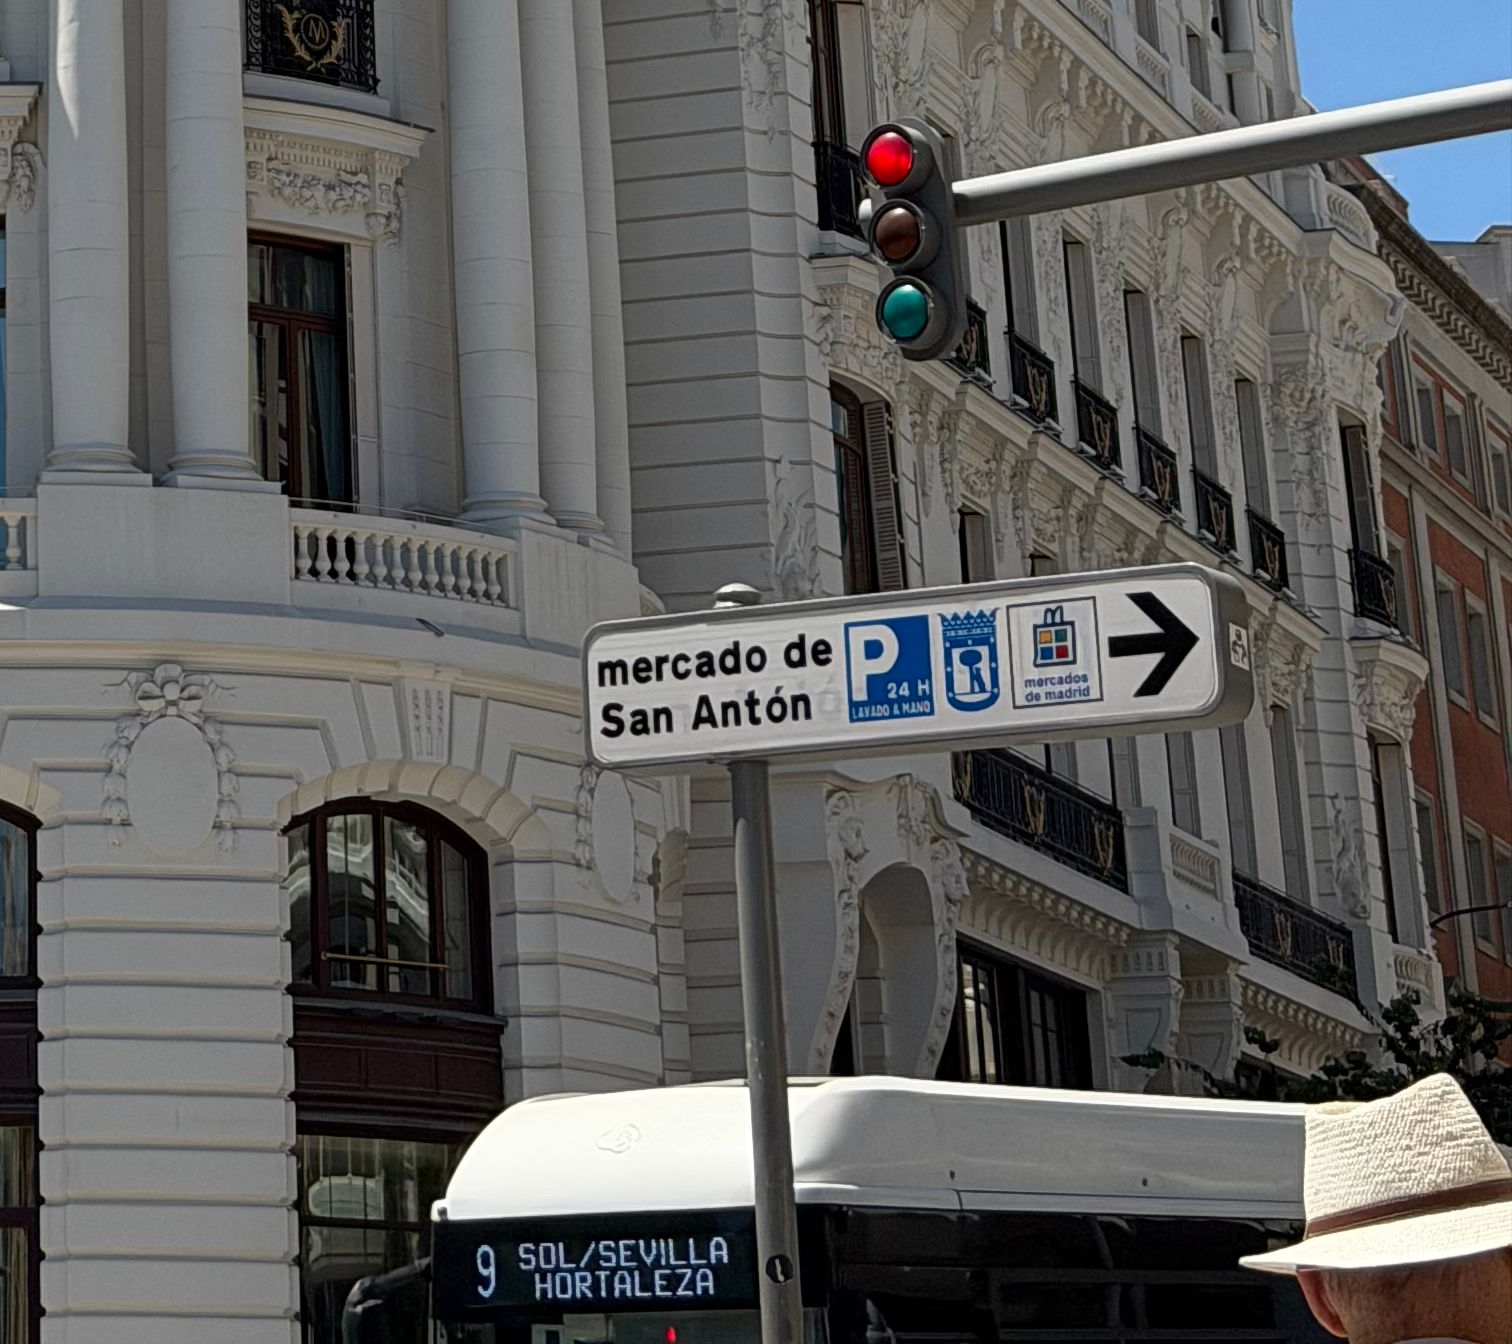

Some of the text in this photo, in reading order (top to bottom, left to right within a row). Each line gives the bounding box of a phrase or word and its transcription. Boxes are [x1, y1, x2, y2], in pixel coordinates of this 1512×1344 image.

[307, 17, 326, 45] M
[597, 632, 834, 688] mercado de
[848, 624, 900, 703] P
[886, 678, 930, 700] 24 H
[1024, 672, 1089, 689] mercados
[1024, 685, 1091, 703] de madrid
[600, 685, 813, 739] San Antón
[851, 699, 931, 721] LAVADO A MANO
[517, 1236, 730, 1271] SOL/SEVILLA
[475, 1243, 497, 1299] 9
[534, 1267, 715, 1301] HORTALEZA
